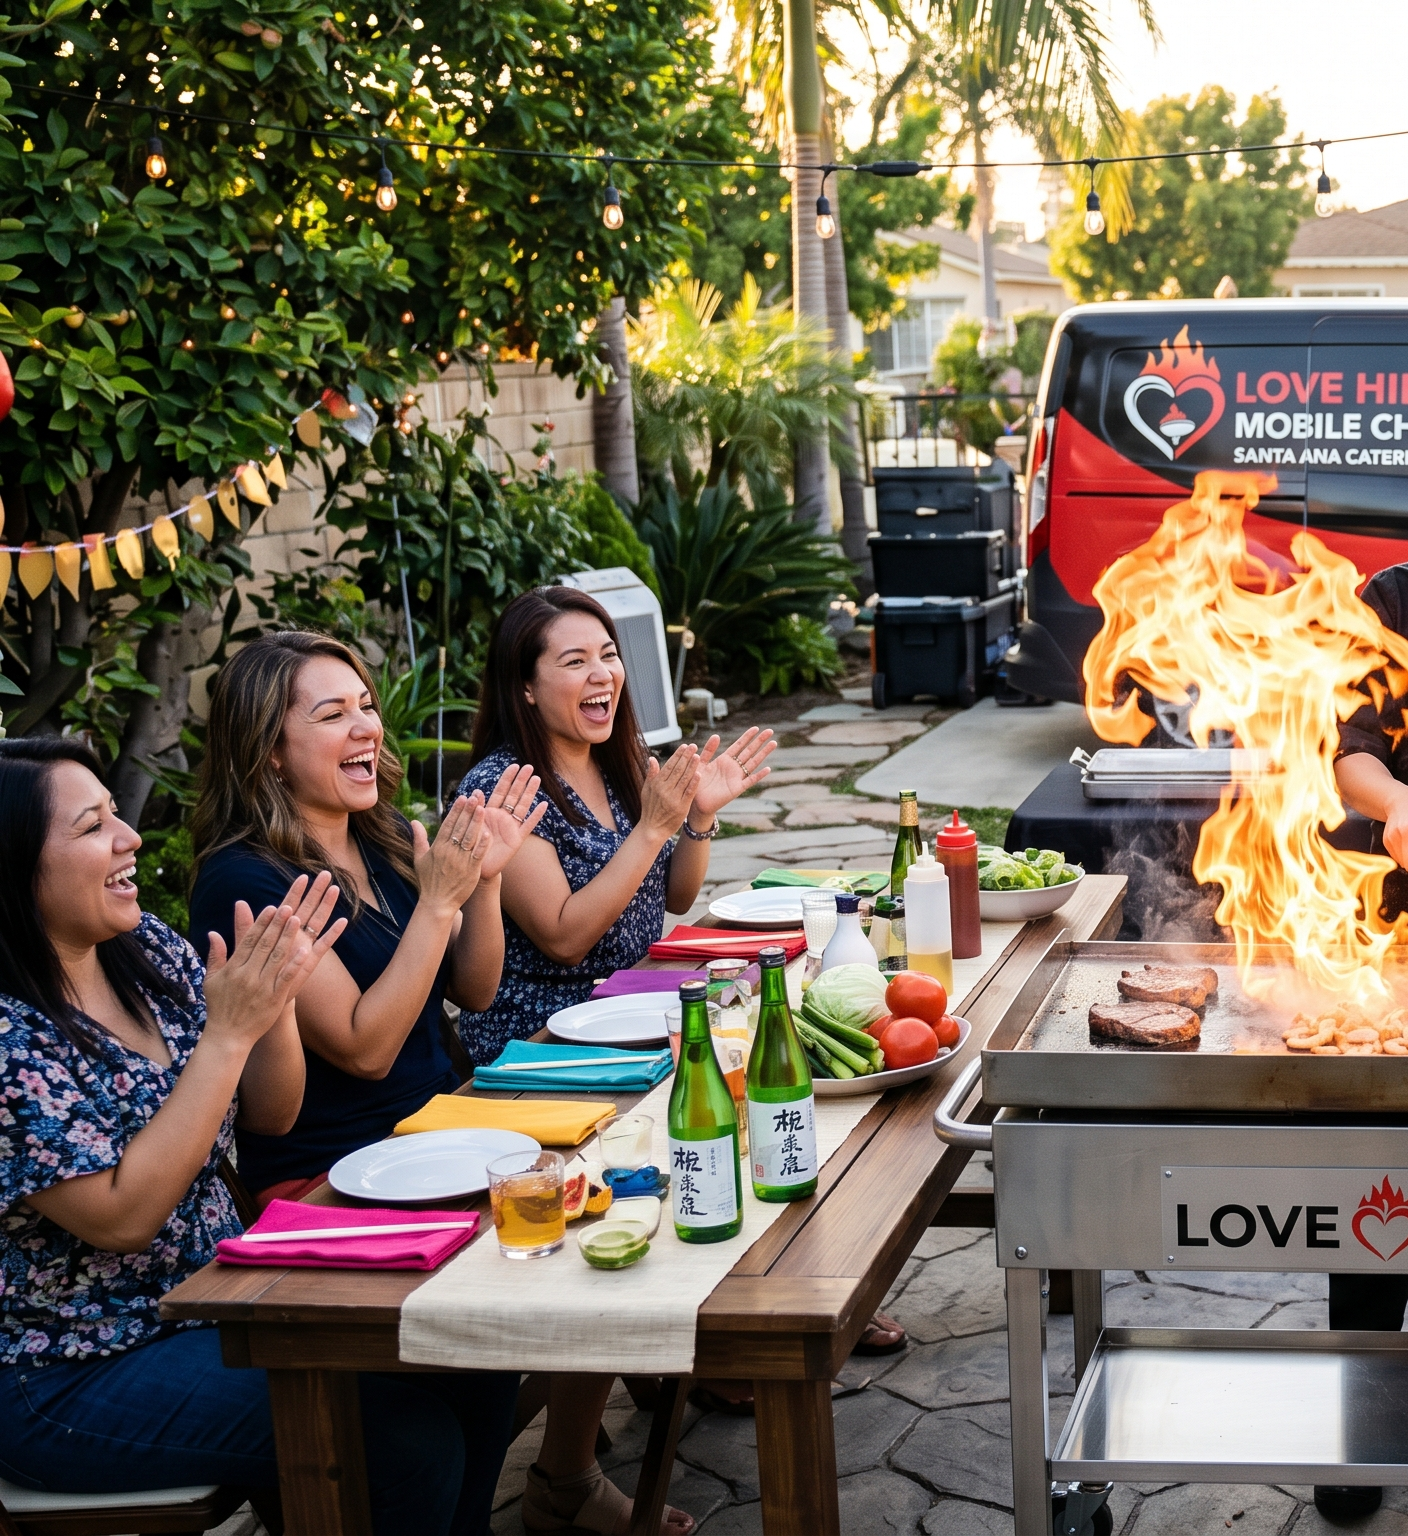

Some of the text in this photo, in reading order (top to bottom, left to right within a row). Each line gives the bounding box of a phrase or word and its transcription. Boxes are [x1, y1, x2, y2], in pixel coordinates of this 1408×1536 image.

[1236, 371, 1344, 405] LOVE
[1234, 411, 1362, 440] MOBILE
[1233, 447, 1297, 464] SANTA
[1298, 447, 1342, 465] ANA
[1176, 1203, 1341, 1249] LOVE
